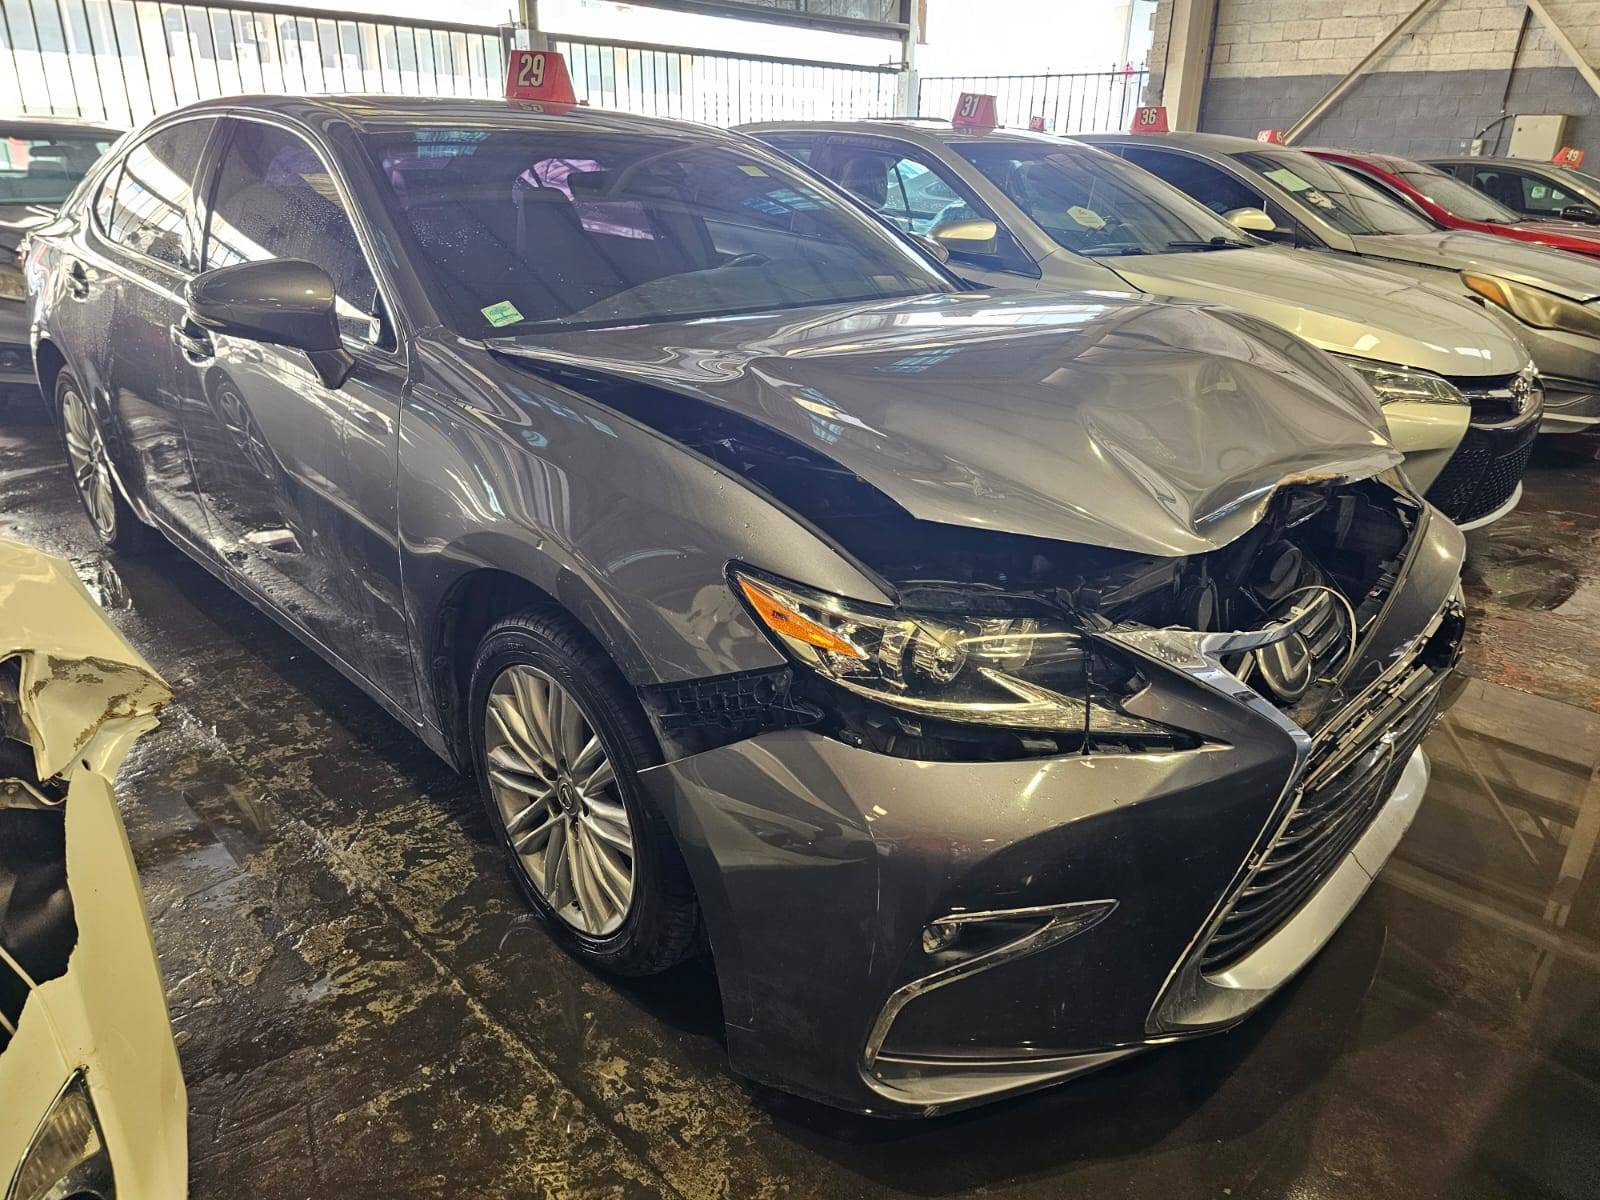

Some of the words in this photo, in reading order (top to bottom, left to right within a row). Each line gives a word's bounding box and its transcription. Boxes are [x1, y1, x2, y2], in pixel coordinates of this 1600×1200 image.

[518, 54, 545, 87] 29
[961, 95, 980, 117] 31
[1141, 108, 1157, 125] 36
